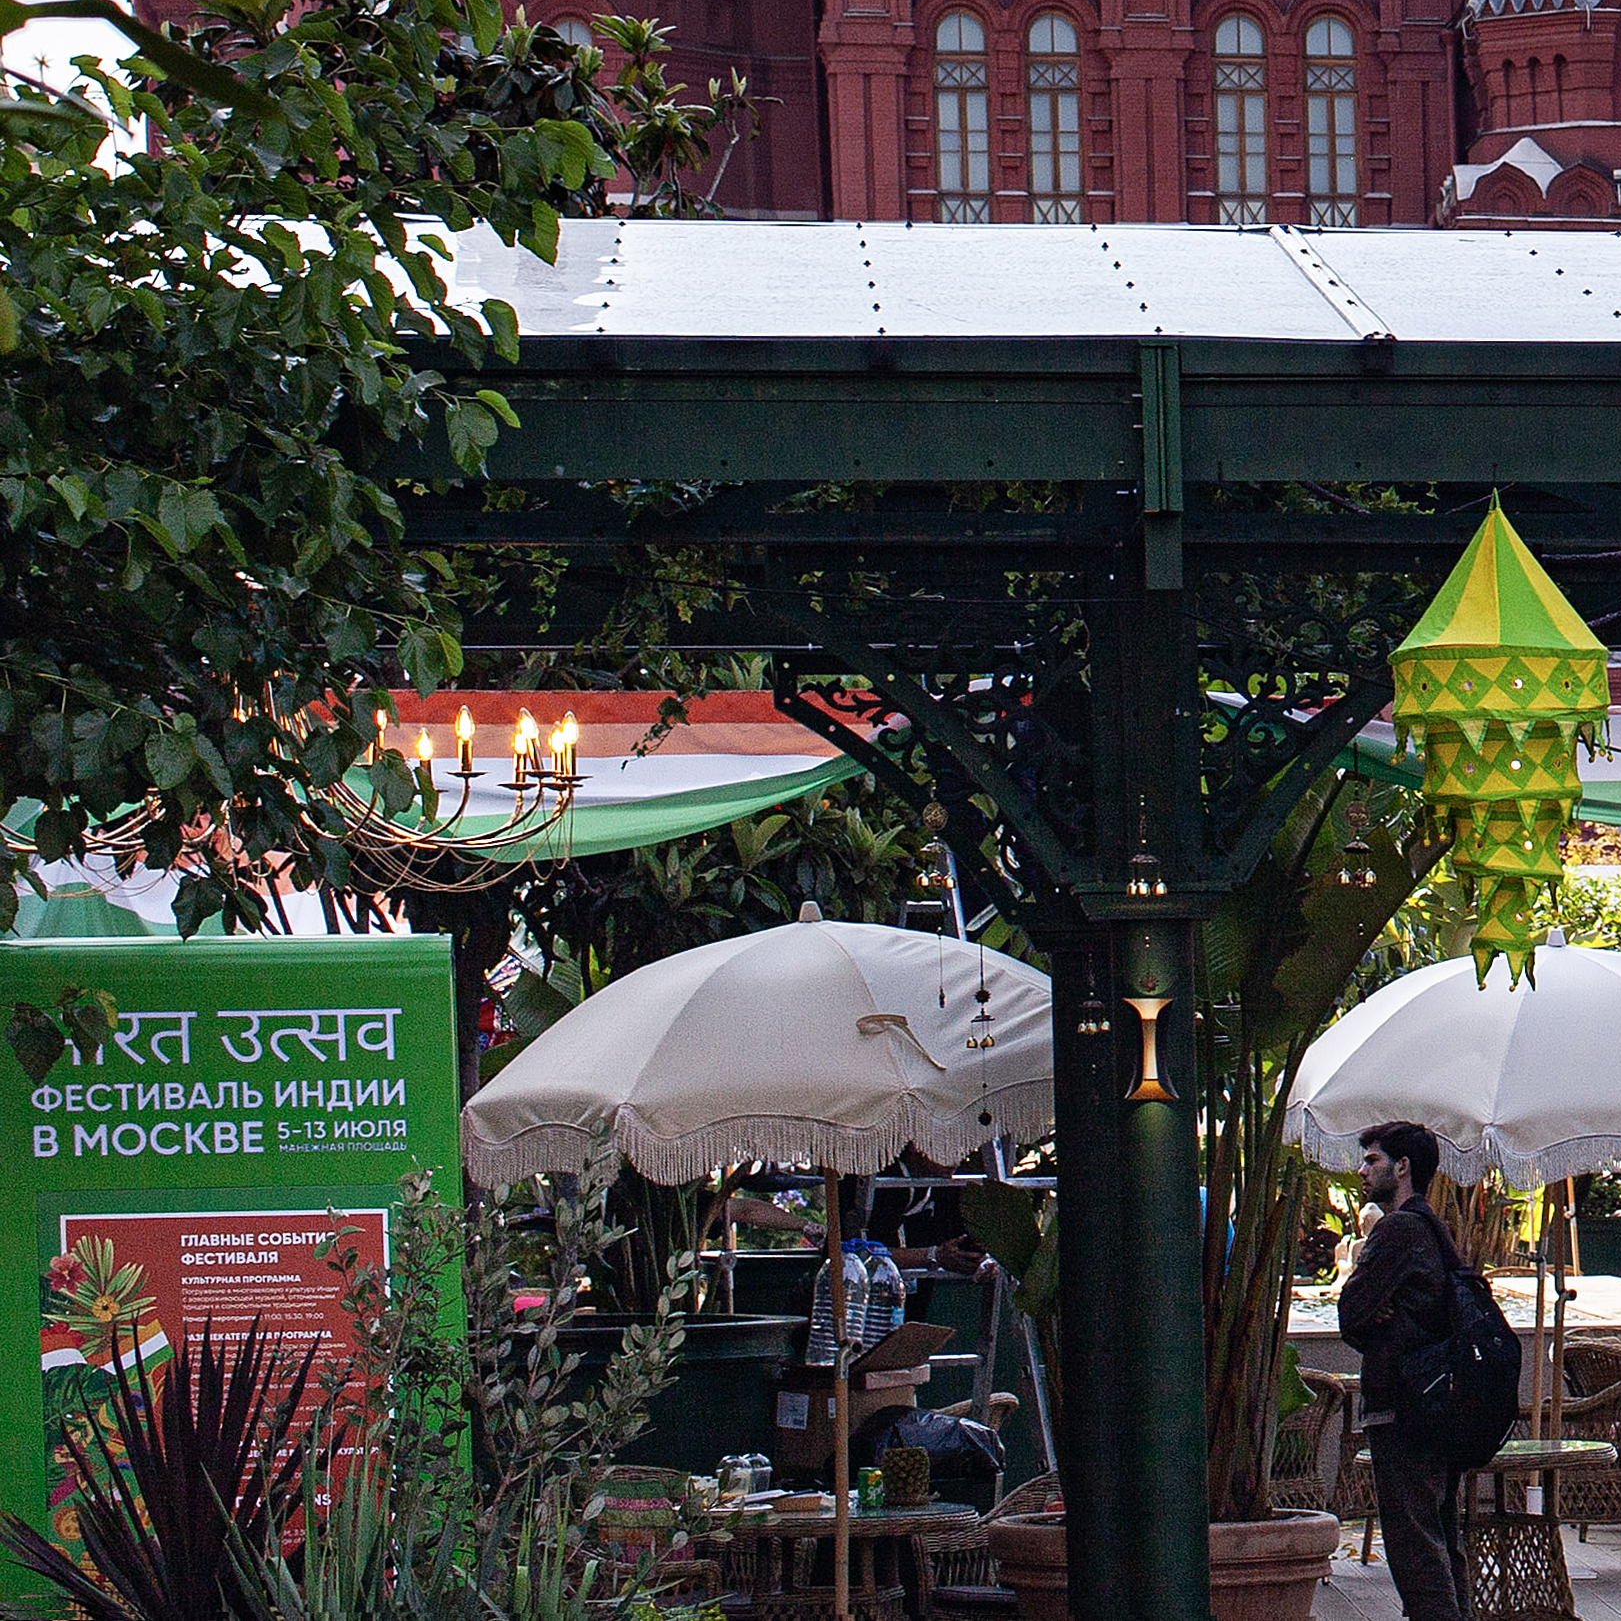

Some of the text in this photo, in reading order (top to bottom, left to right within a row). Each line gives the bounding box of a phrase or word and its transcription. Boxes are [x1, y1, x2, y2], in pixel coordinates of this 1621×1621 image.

[217, 1008, 403, 1063] उत्सव
[30, 1079, 406, 1114] ФЕСТИВАЛЬ ИНДИИ
[334, 1119, 407, 1138] ИЮЛЯ
[33, 1120, 265, 1157] В МОСКВЕ
[279, 1141, 408, 1153] МАНЕЖНАЯ ПЛОЩАДЬ
[180, 1234, 254, 1247] ГЛАВНЫЕ
[180, 1251, 279, 1266] ФЕСТИВАЛЯ
[181, 1274, 302, 1285] КУЛЬТУРНАЯ ПРОГРАММА
